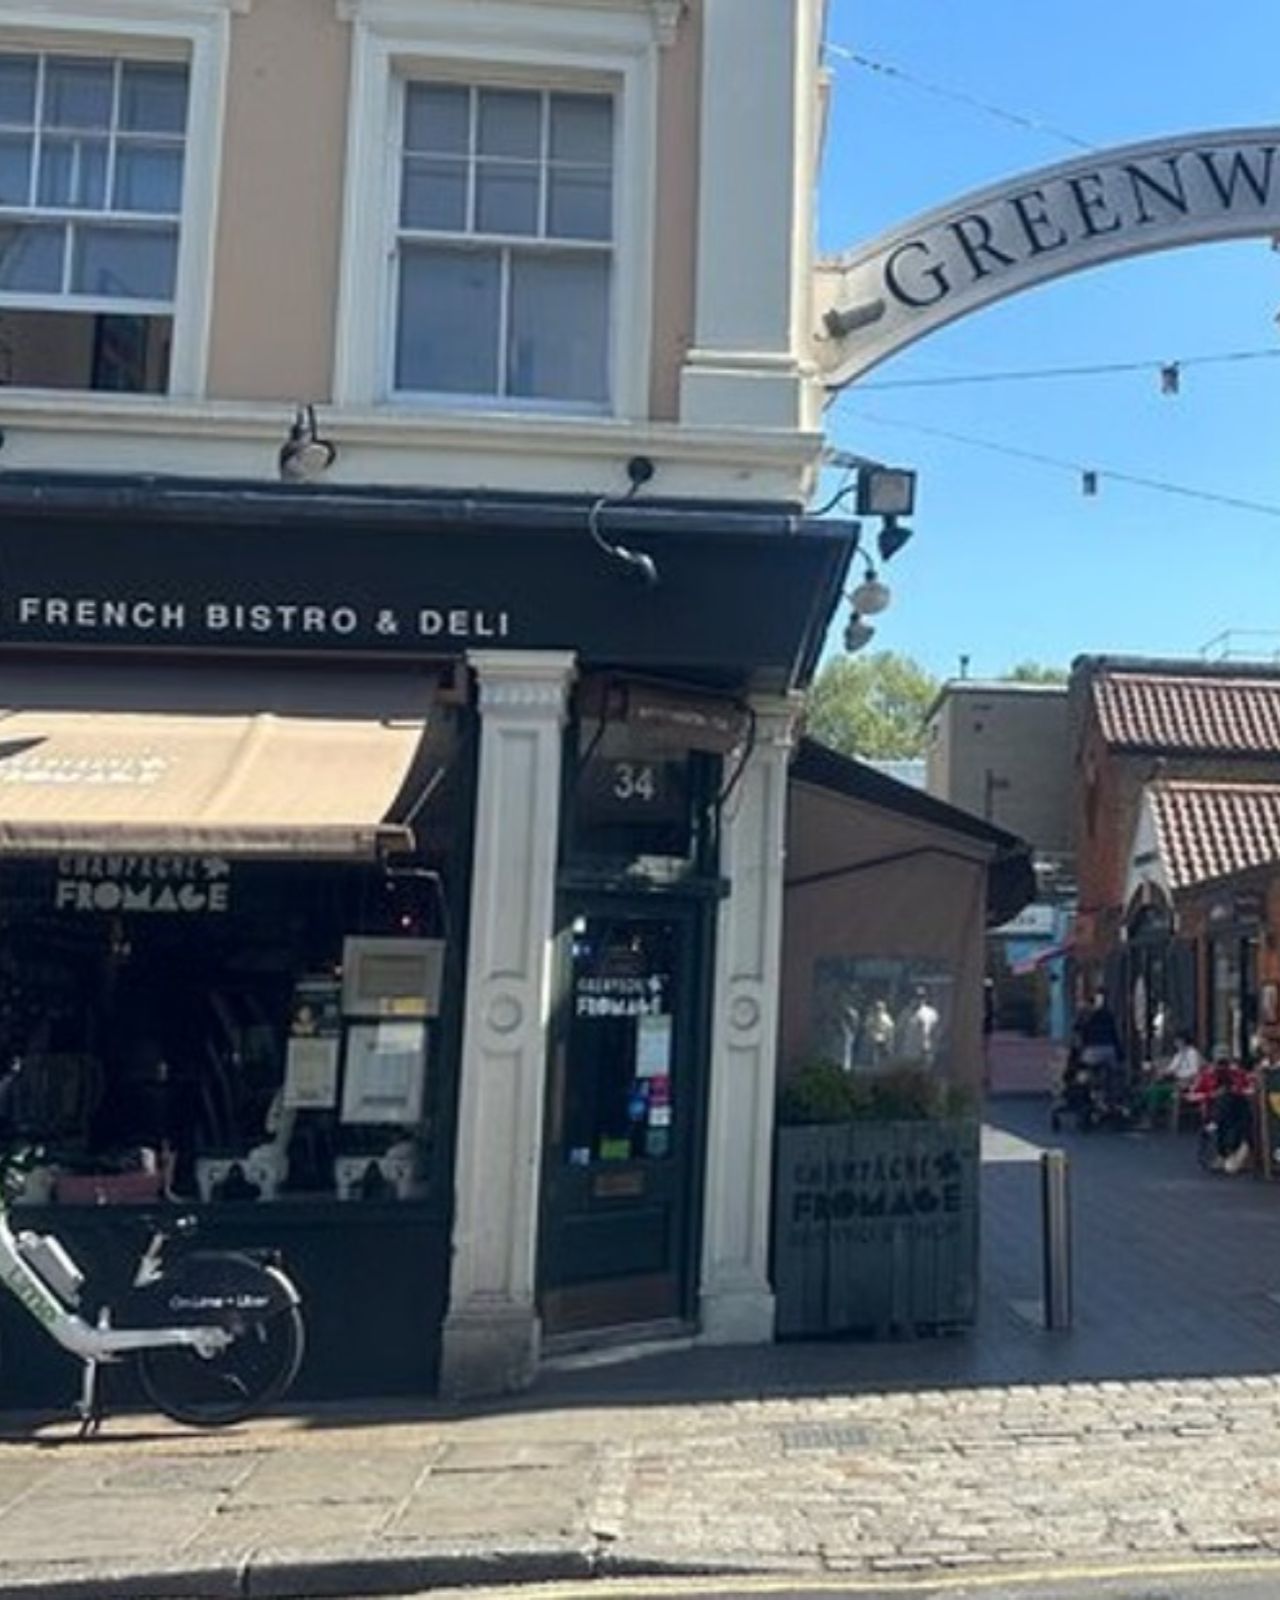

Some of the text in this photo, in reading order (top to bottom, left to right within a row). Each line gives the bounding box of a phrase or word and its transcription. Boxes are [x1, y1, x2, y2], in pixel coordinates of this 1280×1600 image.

[19, 597, 509, 636] FRENCH BISTRO & DELI
[613, 762, 654, 800] 34
[56, 880, 230, 911] FROMAGE
[792, 1182, 962, 1222] FROMAGE
